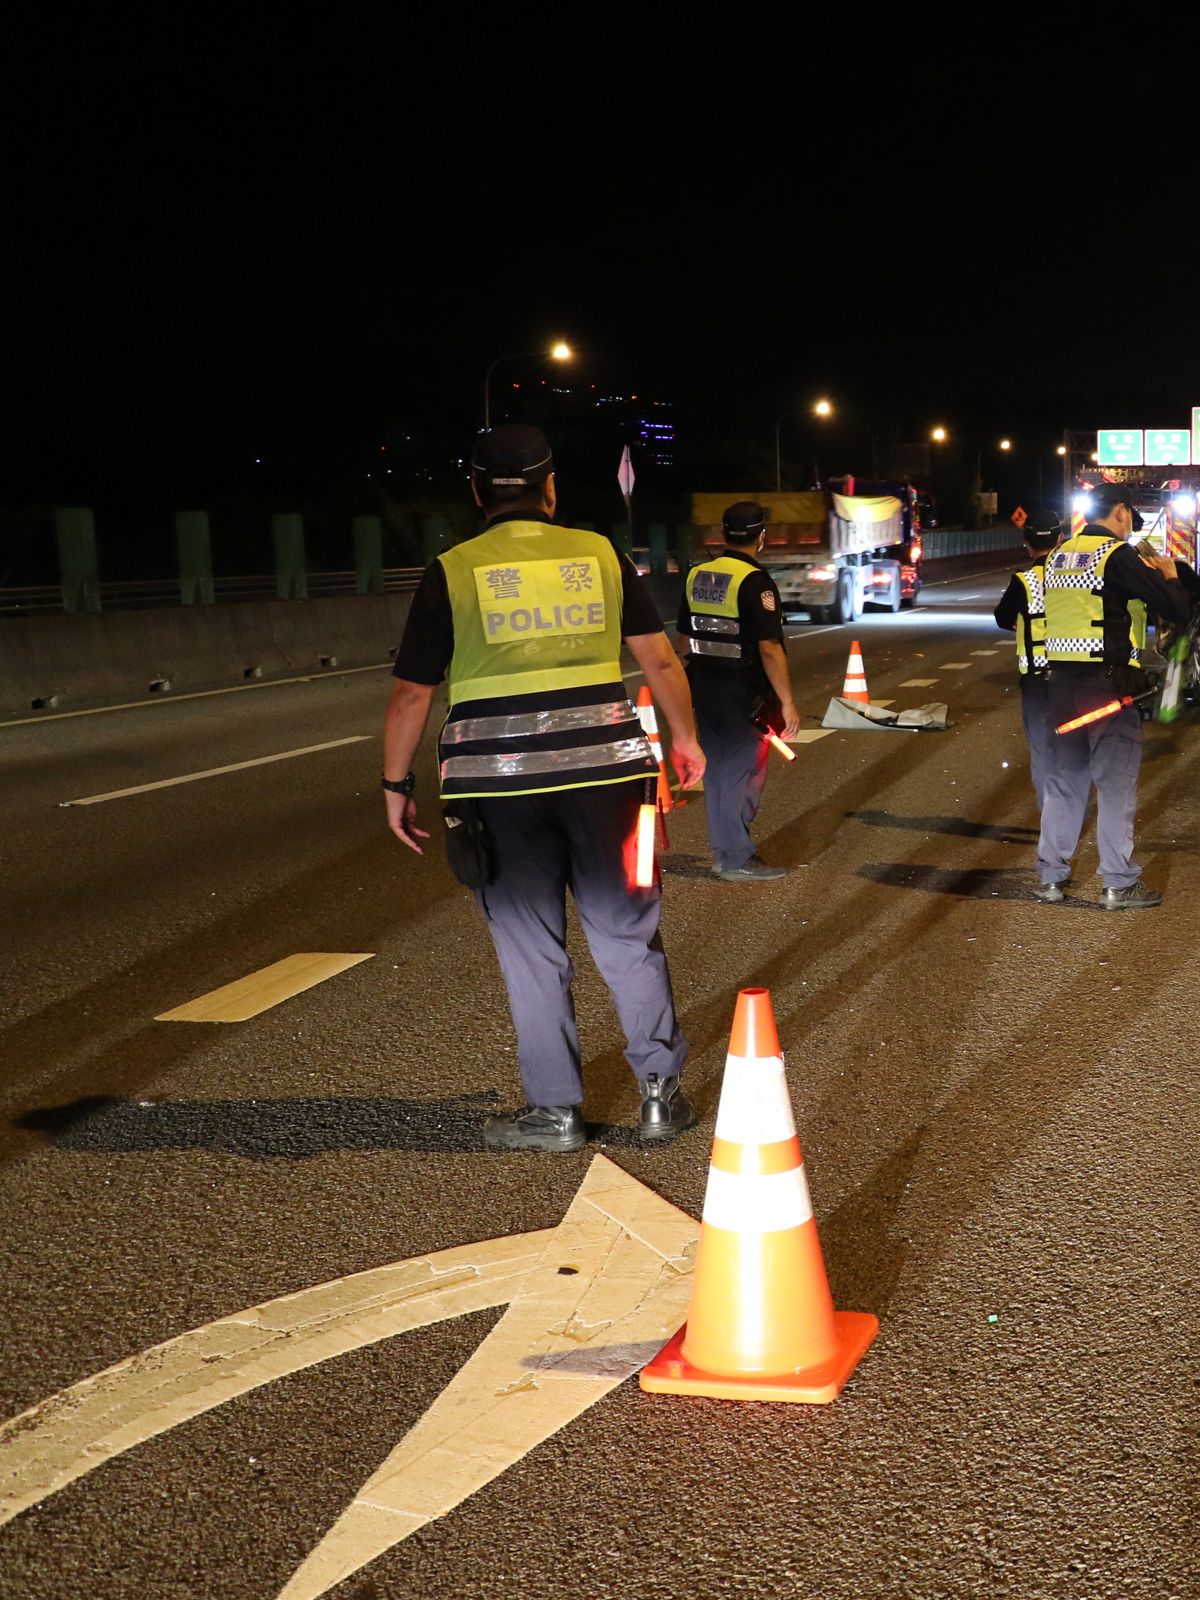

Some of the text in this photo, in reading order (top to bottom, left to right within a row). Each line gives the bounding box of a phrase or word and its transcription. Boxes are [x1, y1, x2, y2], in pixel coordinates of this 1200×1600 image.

[485, 562, 592, 599] 警察
[693, 586, 725, 602] POLICE
[487, 602, 604, 635] POLICE
